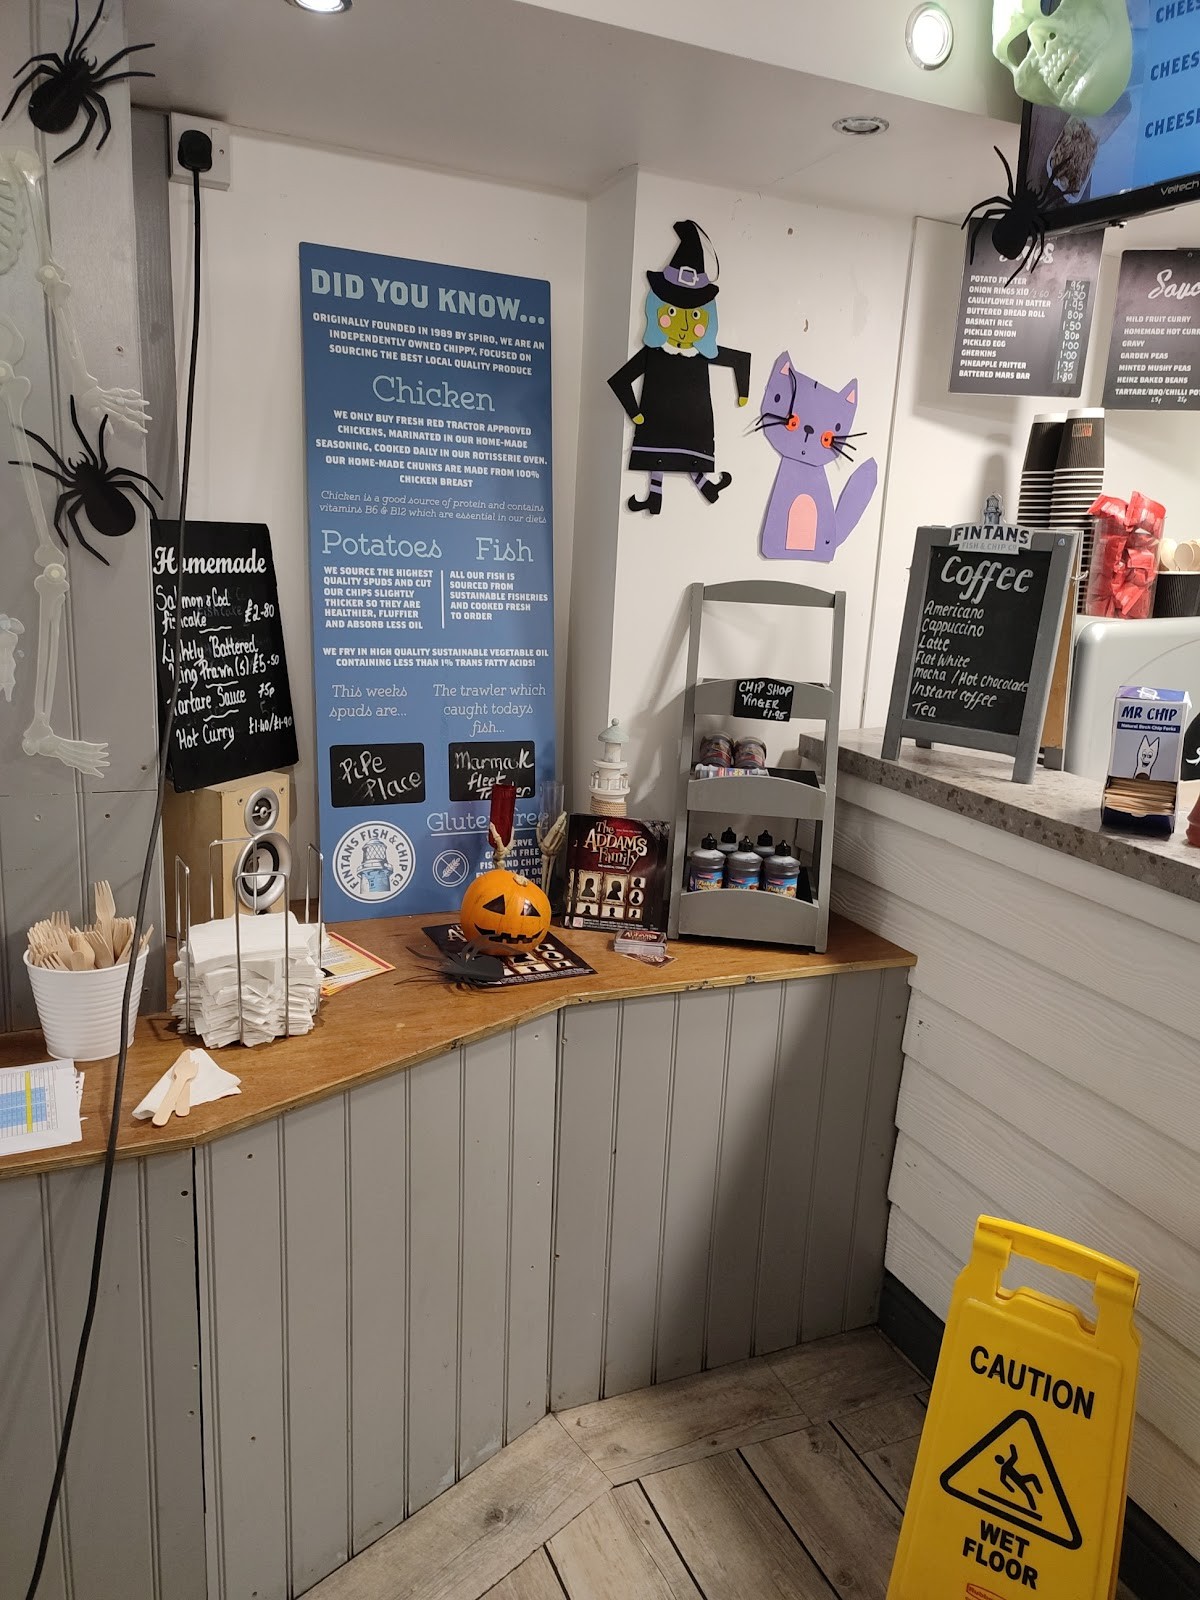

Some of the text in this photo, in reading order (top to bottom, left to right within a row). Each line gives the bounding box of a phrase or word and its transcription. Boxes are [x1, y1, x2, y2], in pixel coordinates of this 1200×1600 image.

[971, 275, 998, 283] POTATO
[311, 268, 545, 325] DID YOU KNOW...
[968, 297, 1014, 305] CAULIFLOWER
[966, 307, 1002, 316] BUTTERED
[1004, 309, 1027, 317] BREAD
[313, 312, 369, 328] ORIGINALLY
[372, 321, 416, 334] FOUNDED
[418, 327, 428, 335] IN
[431, 328, 452, 339] 1989
[455, 332, 466, 340] BY
[500, 337, 513, 346] WE
[515, 339, 531, 349] ARE
[533, 341, 544, 350] AN
[330, 330, 406, 347] INDEPENDENTLY
[408, 340, 441, 351] OWNED
[480, 348, 517, 360] FOCUSED
[520, 353, 531, 362] ON
[961, 349, 996, 357] GHERKINS
[959, 370, 993, 378] BATTERED
[999, 361, 1026, 369] FRITTER
[373, 375, 495, 412] Chicken
[954, 526, 1029, 544] FINTANS
[322, 530, 534, 562] Potatoes Fish
[450, 570, 515, 580] ALL OUR FISH IS
[940, 555, 1034, 604] Coffee
[212, 587, 231, 606] Cod
[924, 600, 984, 620] Americano
[922, 618, 984, 638] Cappuccino
[162, 634, 259, 666] Lihtly Battered
[323, 648, 337, 656] WE
[339, 648, 355, 656] FRY
[394, 648, 430, 657] QUALITY
[432, 648, 488, 657] SUSTAINABLE
[490, 649, 534, 657] VEGETABLE
[918, 635, 950, 652] Latte
[336, 658, 391, 667] CONTAINING
[394, 659, 414, 667] LESS
[416, 659, 438, 667] THAN
[441, 659, 453, 667] 1%
[455, 659, 482, 667] TRANS
[485, 659, 508, 667] FATTY
[915, 650, 971, 668] Flat White
[217, 686, 247, 707] Sauce
[332, 684, 408, 698] This weeks
[433, 683, 546, 697] The trawler which
[739, 681, 792, 697] CHIP SHOP
[912, 682, 957, 700] Instant
[329, 704, 372, 720] spuds
[444, 702, 533, 721] caught todays
[912, 700, 937, 718] Tea
[1121, 706, 1177, 721] MR CHIP
[176, 727, 199, 750] Hot
[203, 724, 234, 750] Curry
[596, 820, 614, 834] The
[341, 829, 408, 889] FINTANS FISH & CHIP
[970, 1345, 1095, 1419] CAUTION
[980, 1519, 1029, 1558] WET
[962, 1537, 1039, 1590] FLOOR
